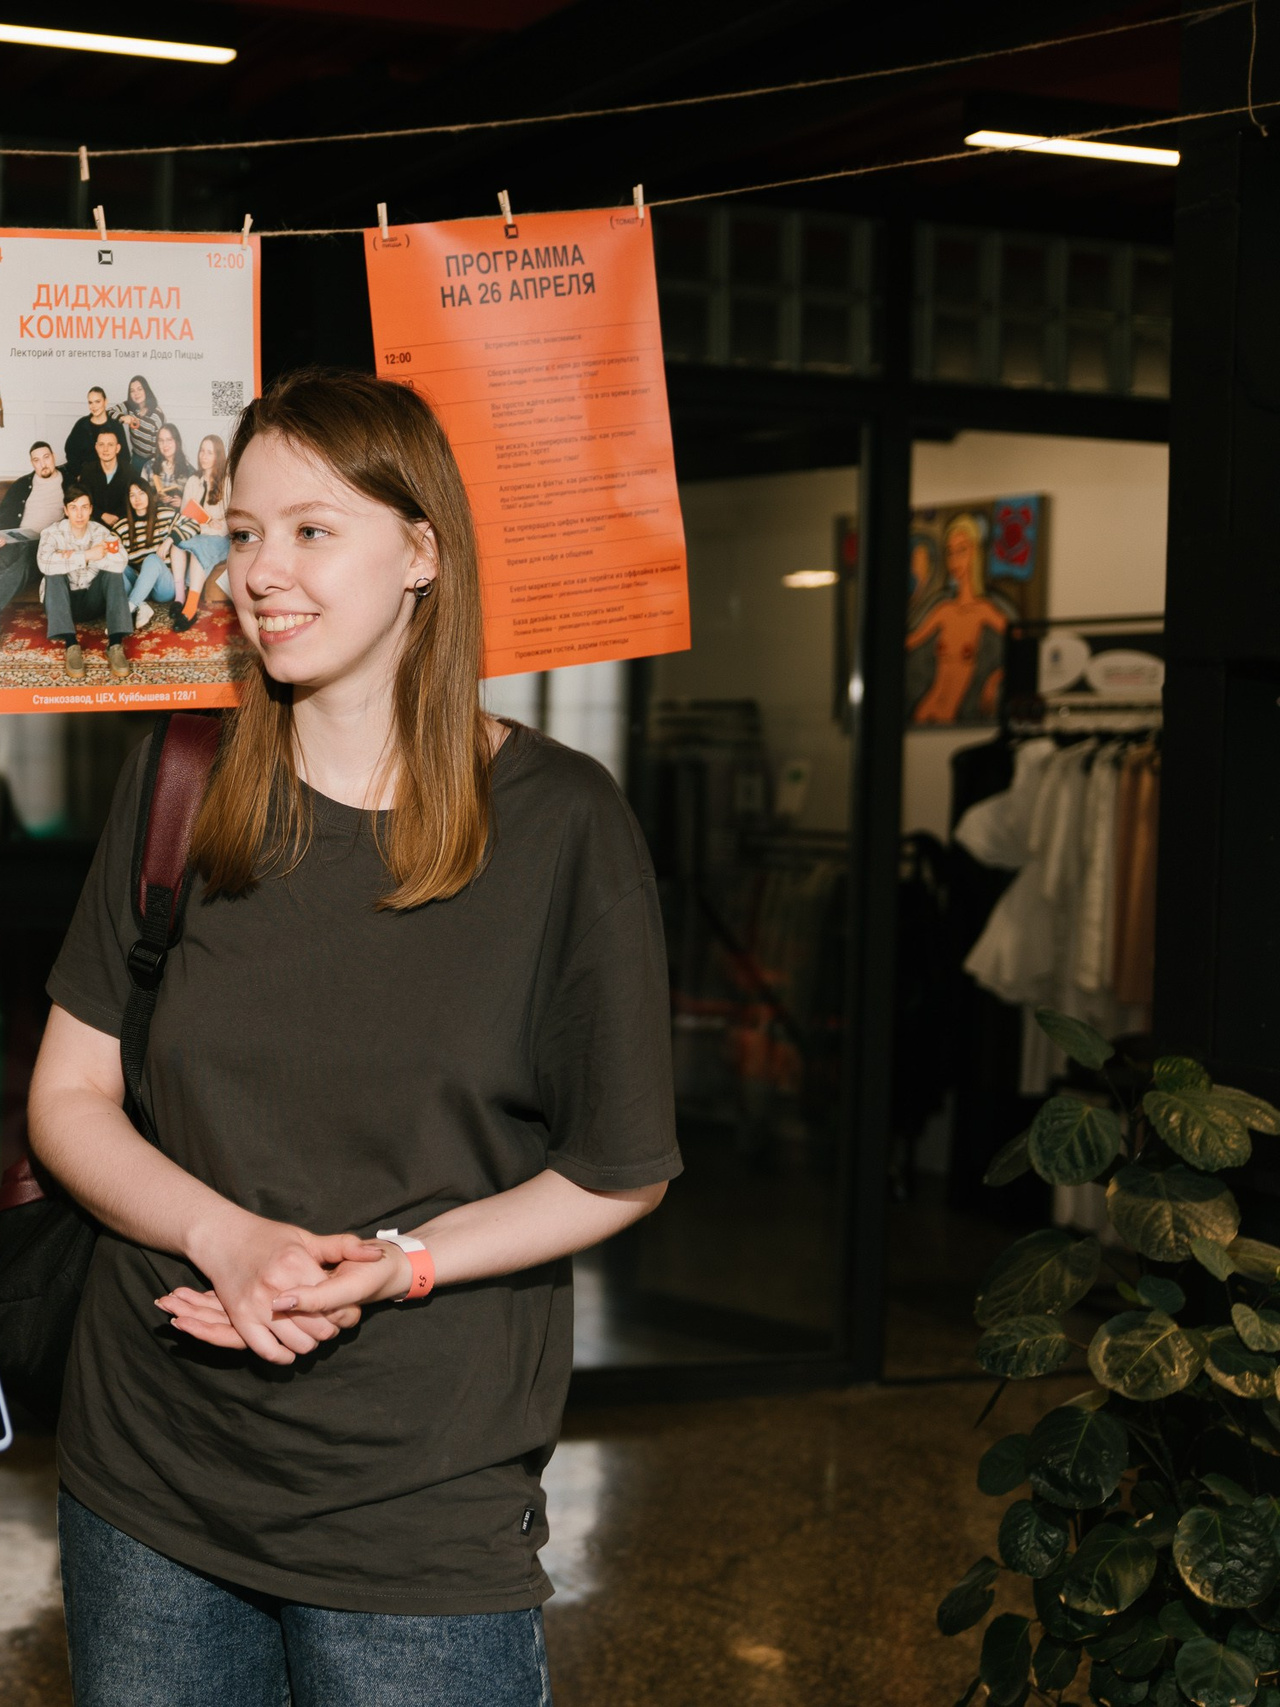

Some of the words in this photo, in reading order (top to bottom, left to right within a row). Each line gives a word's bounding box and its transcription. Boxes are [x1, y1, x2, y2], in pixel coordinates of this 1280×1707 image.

[206, 253, 245, 269] 12:00
[445, 244, 585, 277] ПРОГРАММА
[33, 284, 181, 311] ДИДЖИТАЛ
[440, 284, 472, 308] НА
[477, 282, 502, 305] 26
[509, 272, 596, 301] АПРЕЛЯ
[19, 315, 195, 340] КОММУНАЛКА
[10, 347, 53, 359] Лекторий
[56, 350, 65, 358] от
[68, 350, 112, 359] агентства
[114, 349, 140, 358] Томат
[150, 349, 173, 360] Додо
[175, 350, 204, 360] Пиццы
[384, 352, 412, 365] 12:00
[499, 482, 536, 493] Алгоритмы
[503, 525, 515, 533] Как
[507, 557, 528, 567] Время
[543, 554, 558, 562] кофе
[566, 549, 594, 559] общения
[513, 617, 528, 626] База
[515, 647, 552, 659] Провожаем
[578, 642, 598, 651] дарим
[32, 694, 94, 705] Станкозавод,
[95, 693, 117, 705] ЦЕХ,
[118, 691, 171, 704] Куйбышева
[173, 690, 197, 701] 128/1
